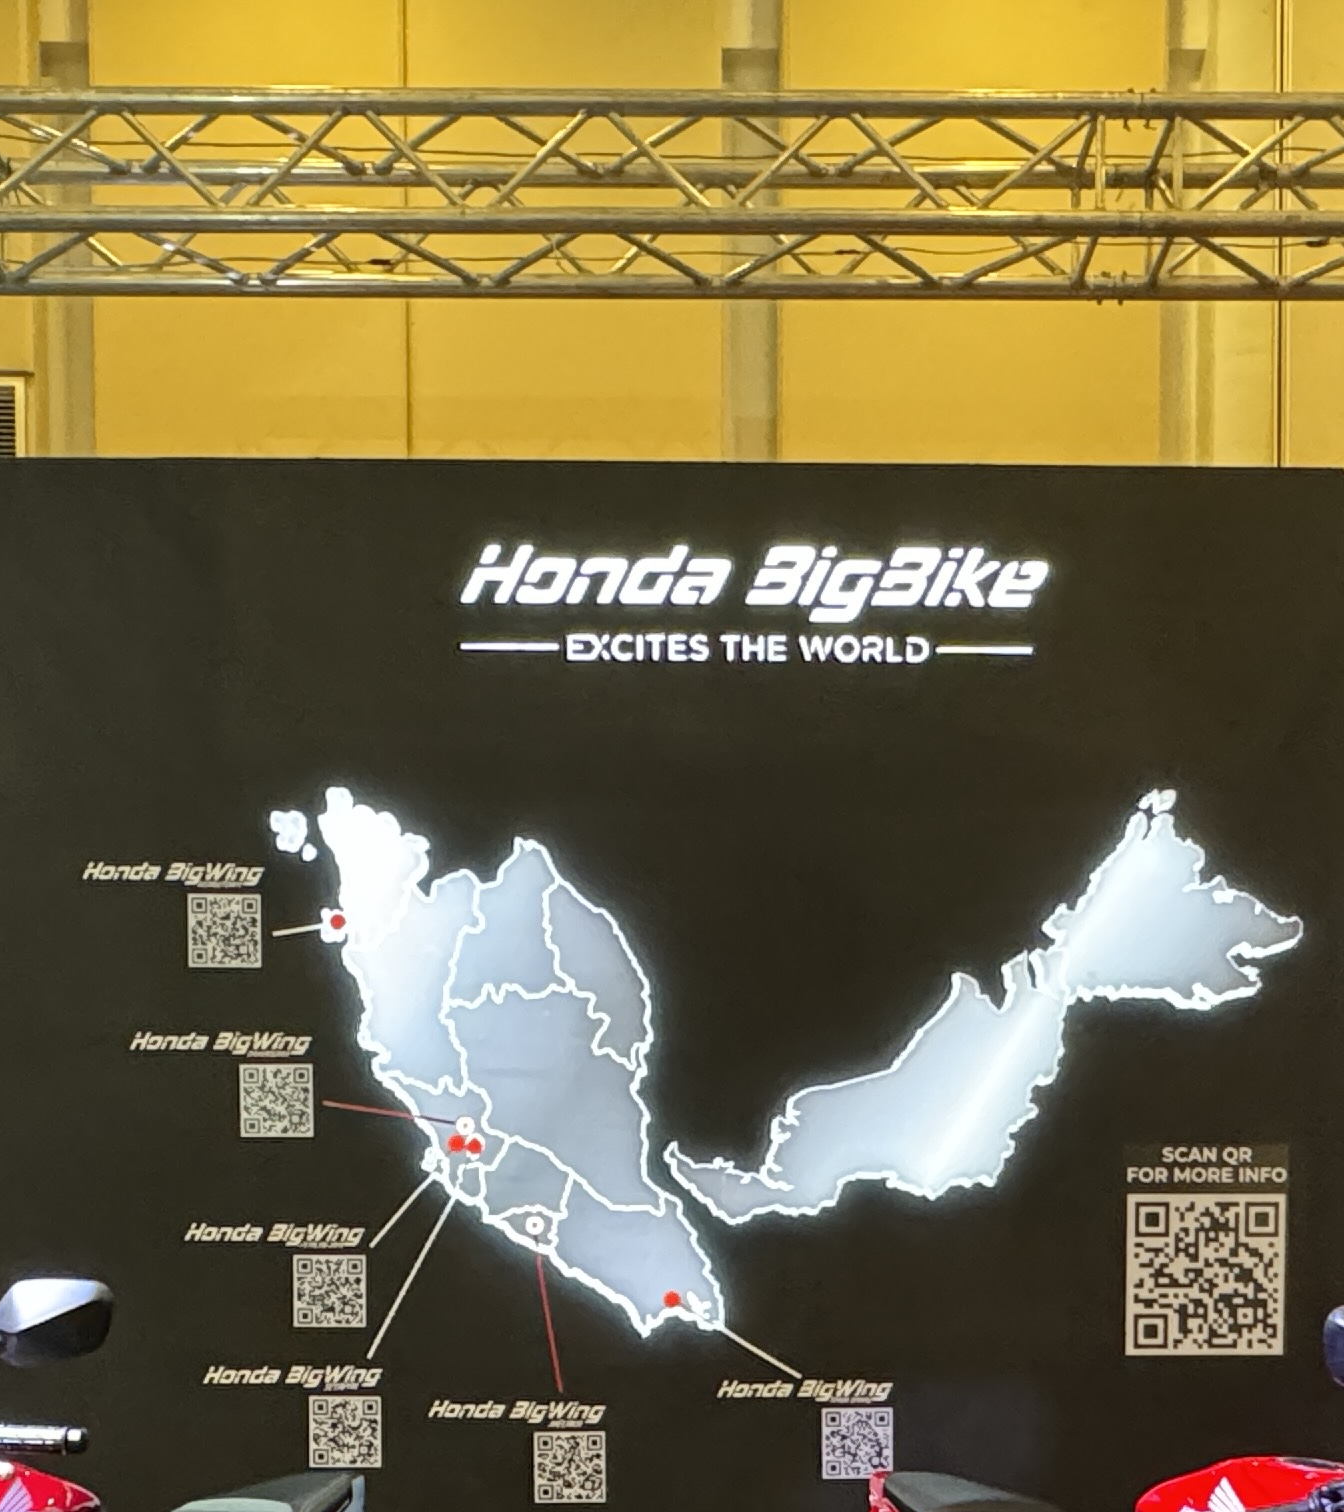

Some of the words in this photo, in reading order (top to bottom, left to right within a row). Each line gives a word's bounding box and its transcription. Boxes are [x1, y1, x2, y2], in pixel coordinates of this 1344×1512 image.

[459, 543, 732, 607] Honda
[744, 544, 1051, 625] BigBike
[565, 632, 710, 662] EXCITES
[719, 633, 788, 662] THE
[798, 634, 930, 664] WORLD
[83, 862, 161, 881] Honda
[165, 862, 265, 886] BigWing
[130, 1031, 209, 1050] Honda
[213, 1031, 313, 1056] BigWing
[1162, 1146, 1218, 1163] SCAN
[1222, 1146, 1253, 1164] QR
[1126, 1166, 1169, 1184] FOR
[1173, 1166, 1234, 1184] MORE
[1238, 1165, 1288, 1184] INFO
[184, 1222, 264, 1242] Honda
[267, 1223, 366, 1247] BigWing
[203, 1366, 282, 1385] Honda
[285, 1366, 383, 1388] BigWing
[717, 1379, 794, 1398] Honda
[797, 1379, 894, 1402] BigWing
[428, 1400, 506, 1419] Honda
[509, 1400, 607, 1424] BigWing
